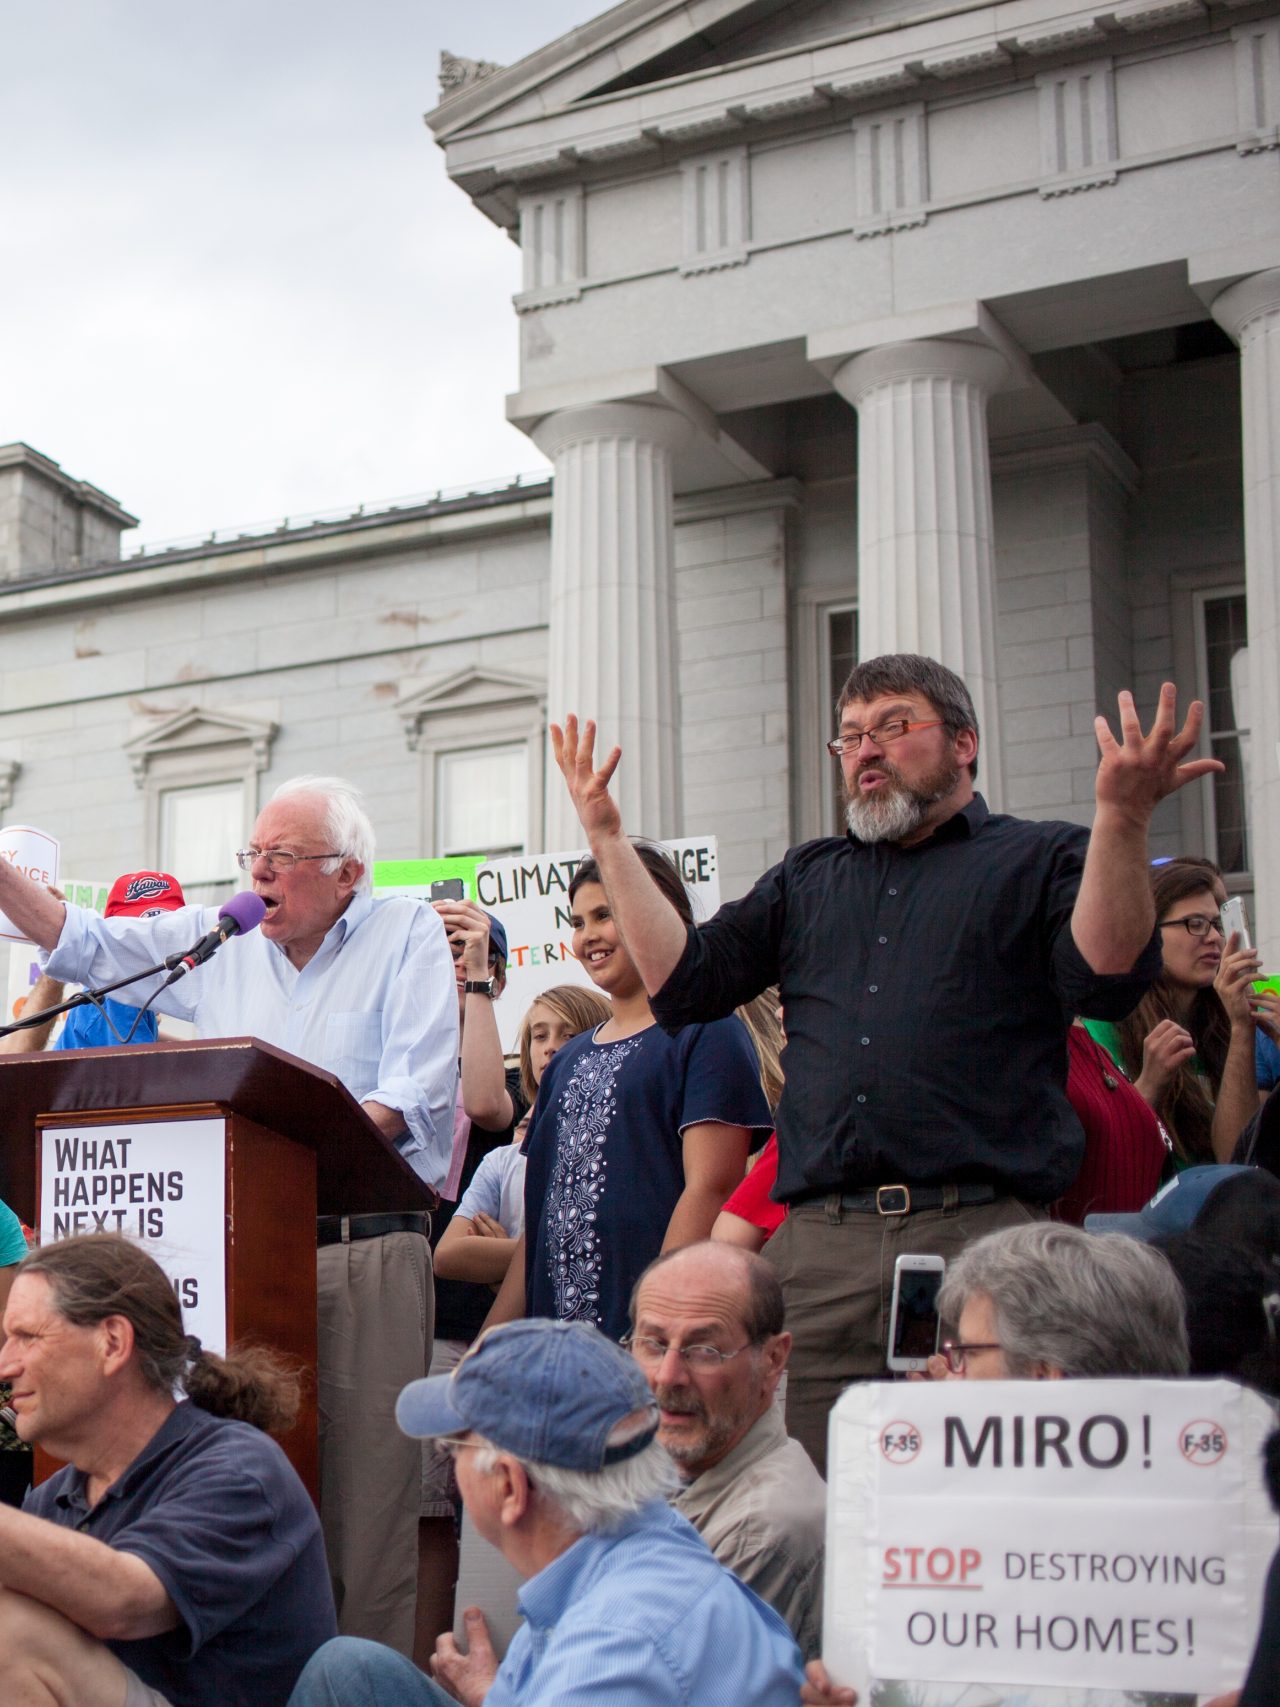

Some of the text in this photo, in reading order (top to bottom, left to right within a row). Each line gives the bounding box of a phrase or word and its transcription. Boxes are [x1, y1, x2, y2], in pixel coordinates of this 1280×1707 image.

[476, 859, 581, 907] CLIMAT
[54, 1171, 183, 1207] HAPPENS
[53, 1208, 163, 1241] NEXT IS
[884, 1415, 1224, 1469] F-35 MIRO! F-35
[882, 1548, 1226, 1586] STOP DESTROYING
[907, 1612, 1195, 1656] OUR HOMES!
